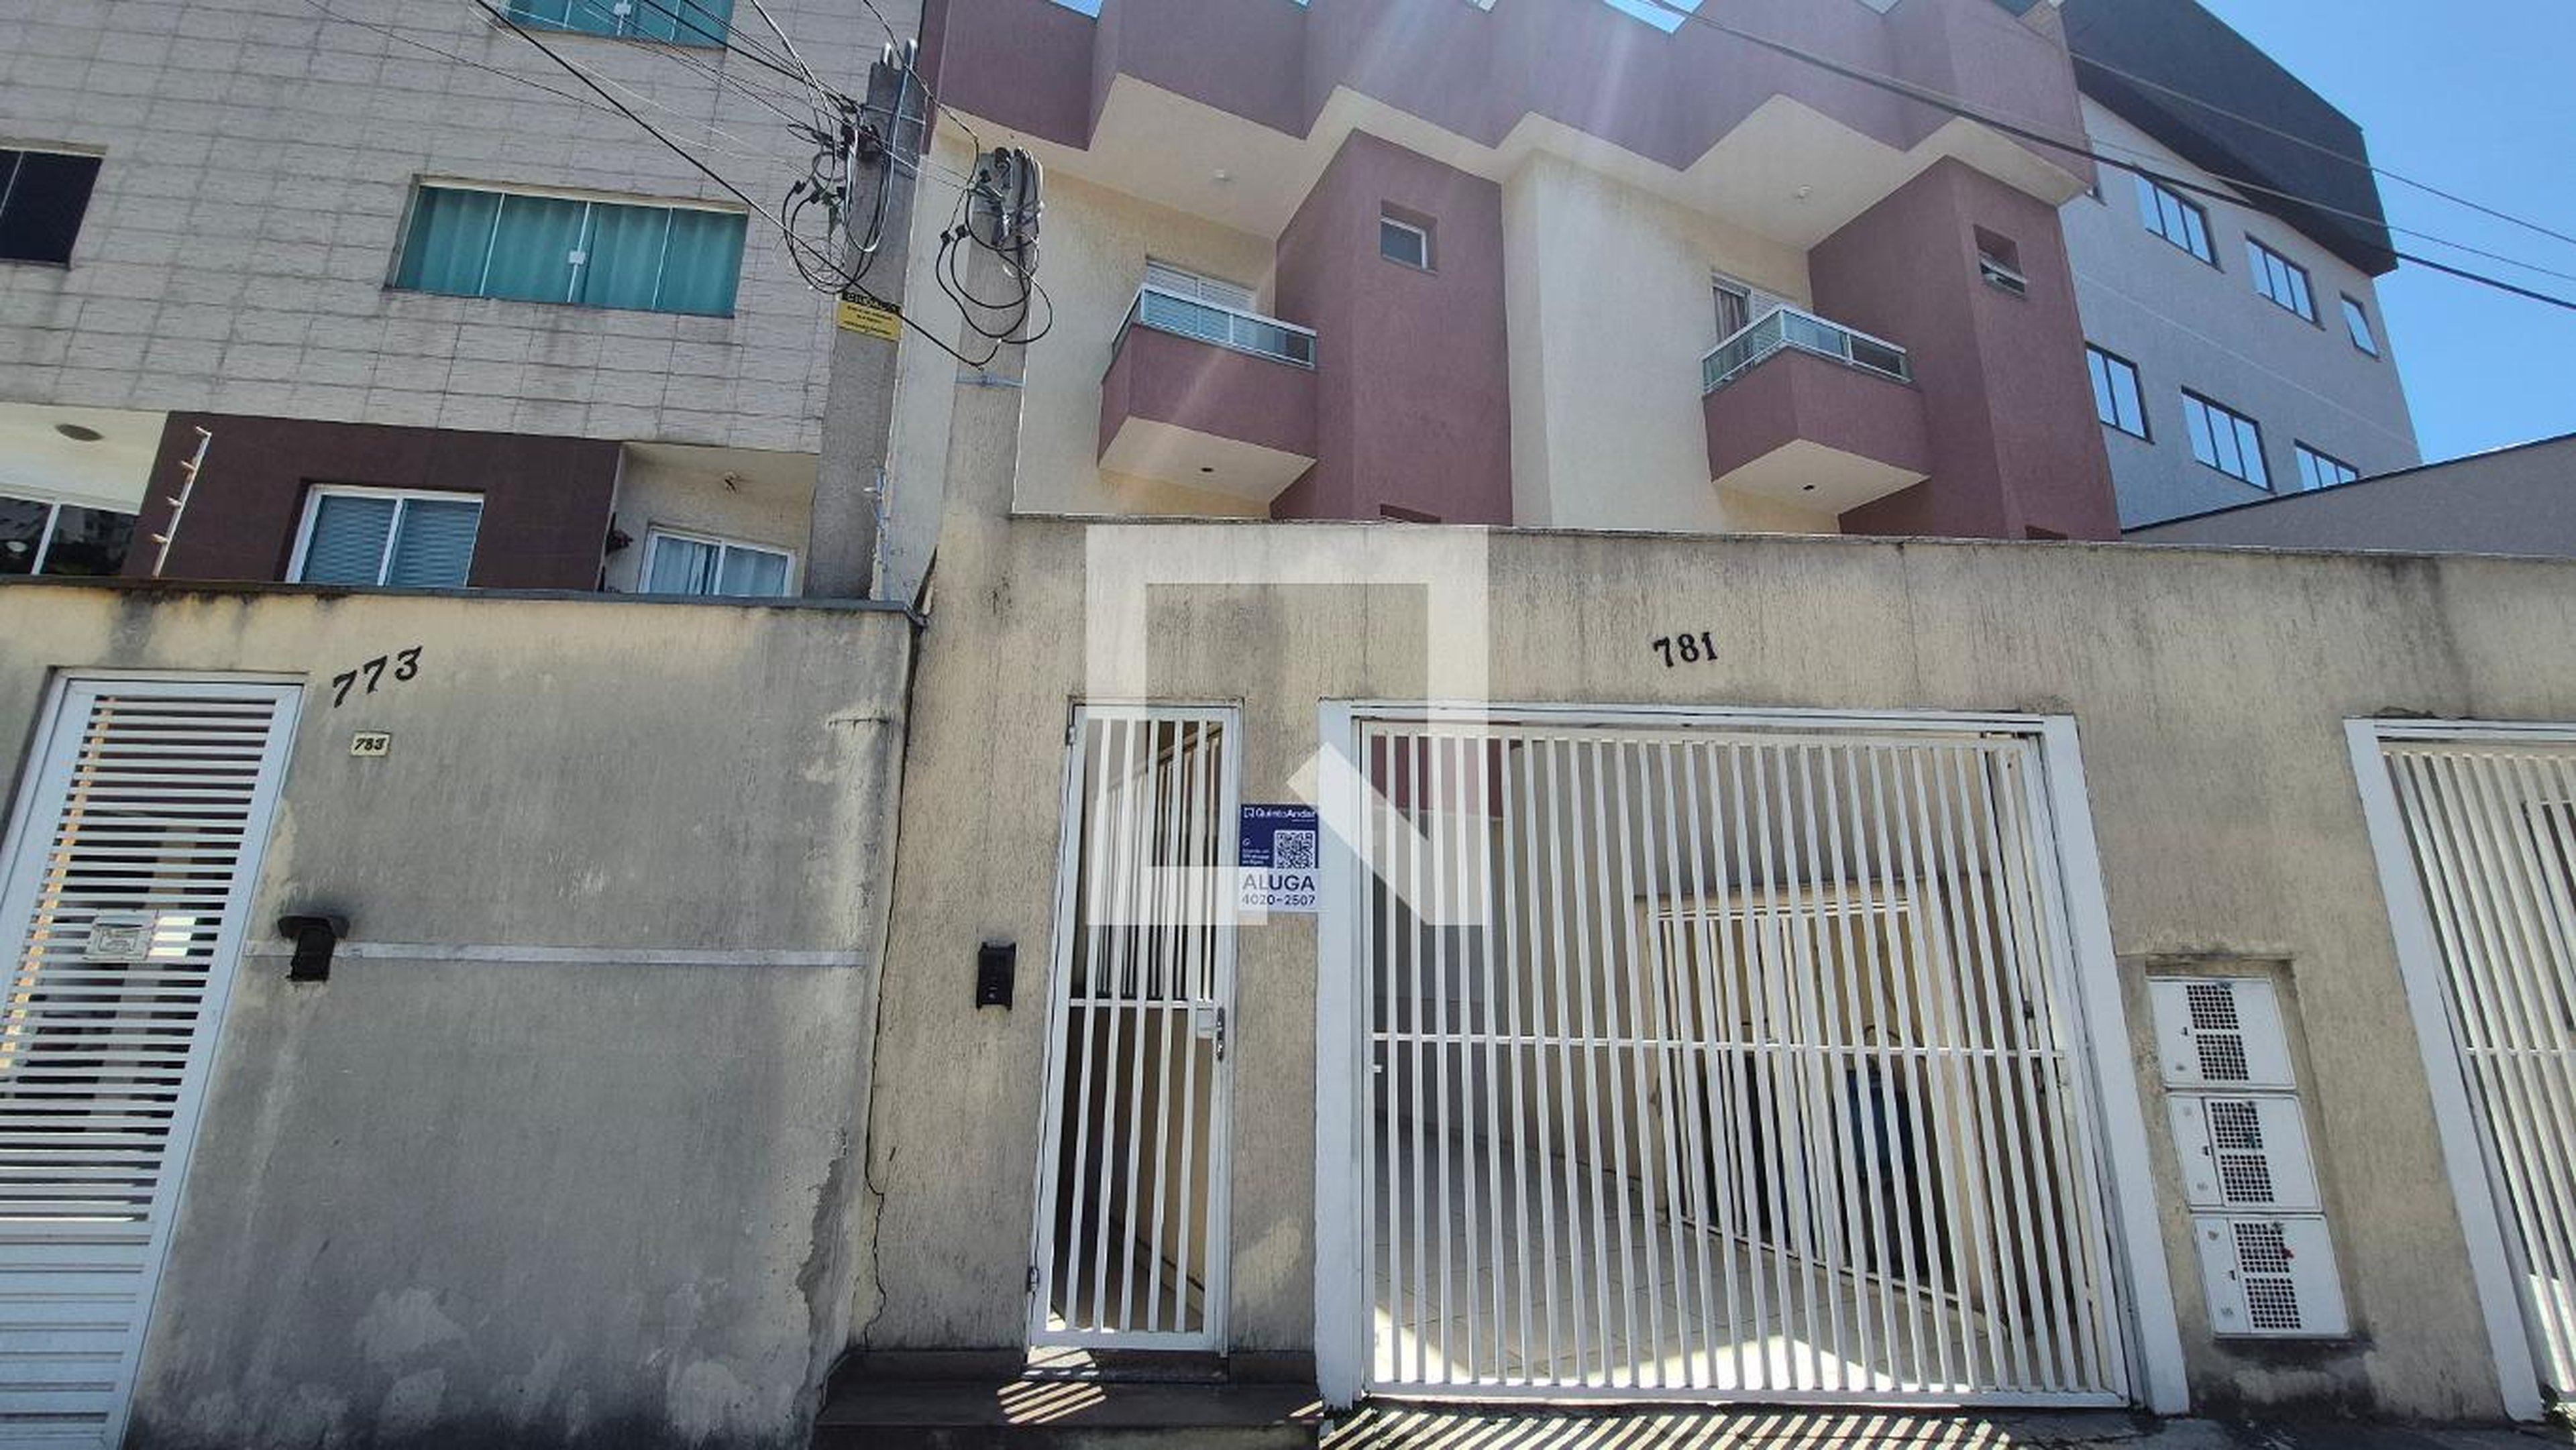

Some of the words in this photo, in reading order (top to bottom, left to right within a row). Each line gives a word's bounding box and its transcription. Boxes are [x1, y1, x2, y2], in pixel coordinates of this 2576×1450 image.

[1652, 631, 1718, 667] 781
[332, 645, 423, 708] 773
[1255, 807, 1316, 818] QuintoAndar
[1242, 873, 1316, 891] ALUGA
[1242, 893, 1316, 906] 4020-2507
